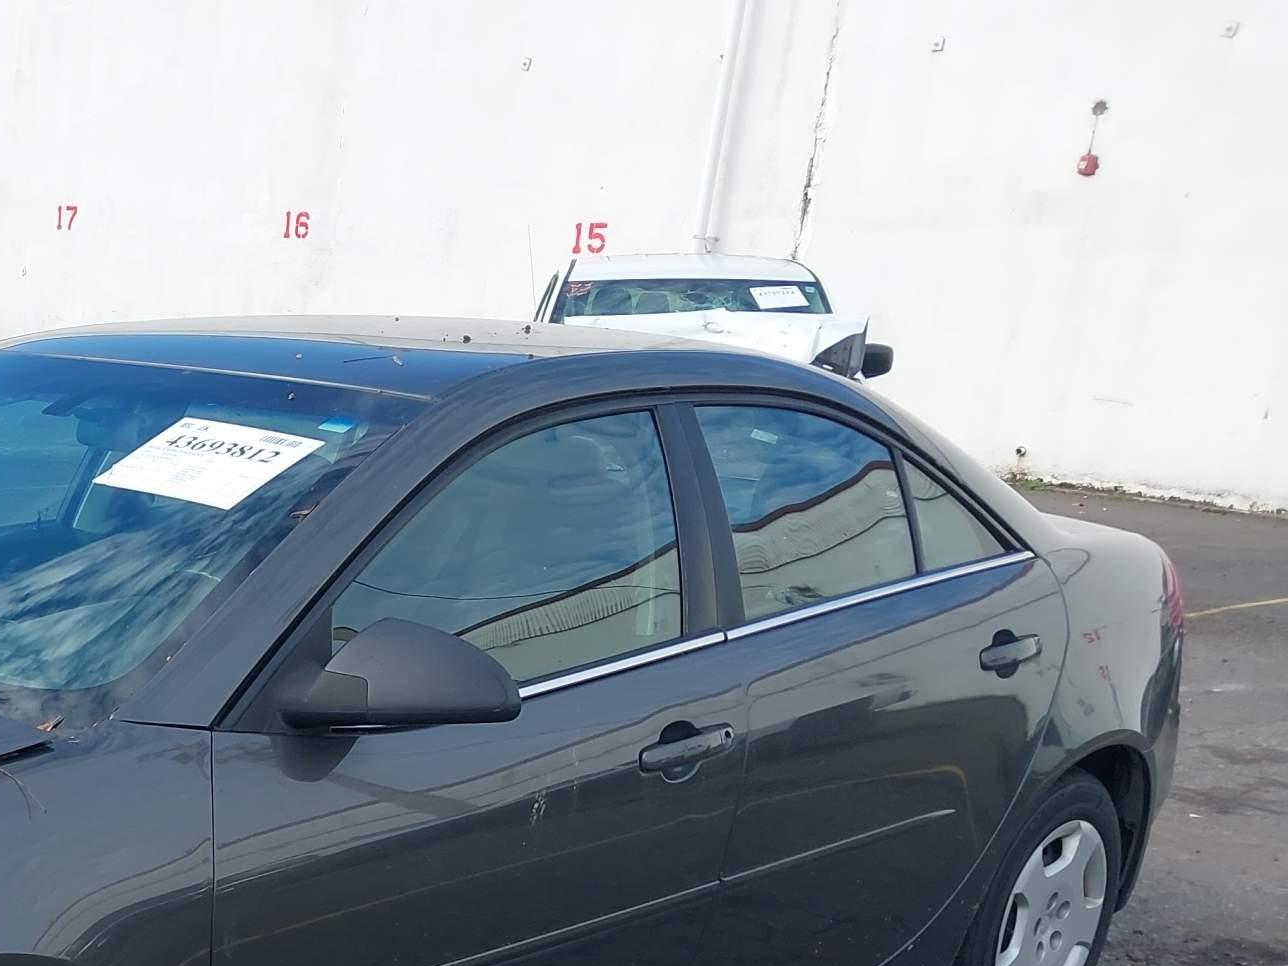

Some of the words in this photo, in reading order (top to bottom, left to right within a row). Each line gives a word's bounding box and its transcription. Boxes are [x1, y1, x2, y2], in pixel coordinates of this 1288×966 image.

[57, 205, 78, 230] 17
[284, 211, 310, 239] 16
[572, 222, 608, 254] 15
[165, 434, 281, 463] 43693812
